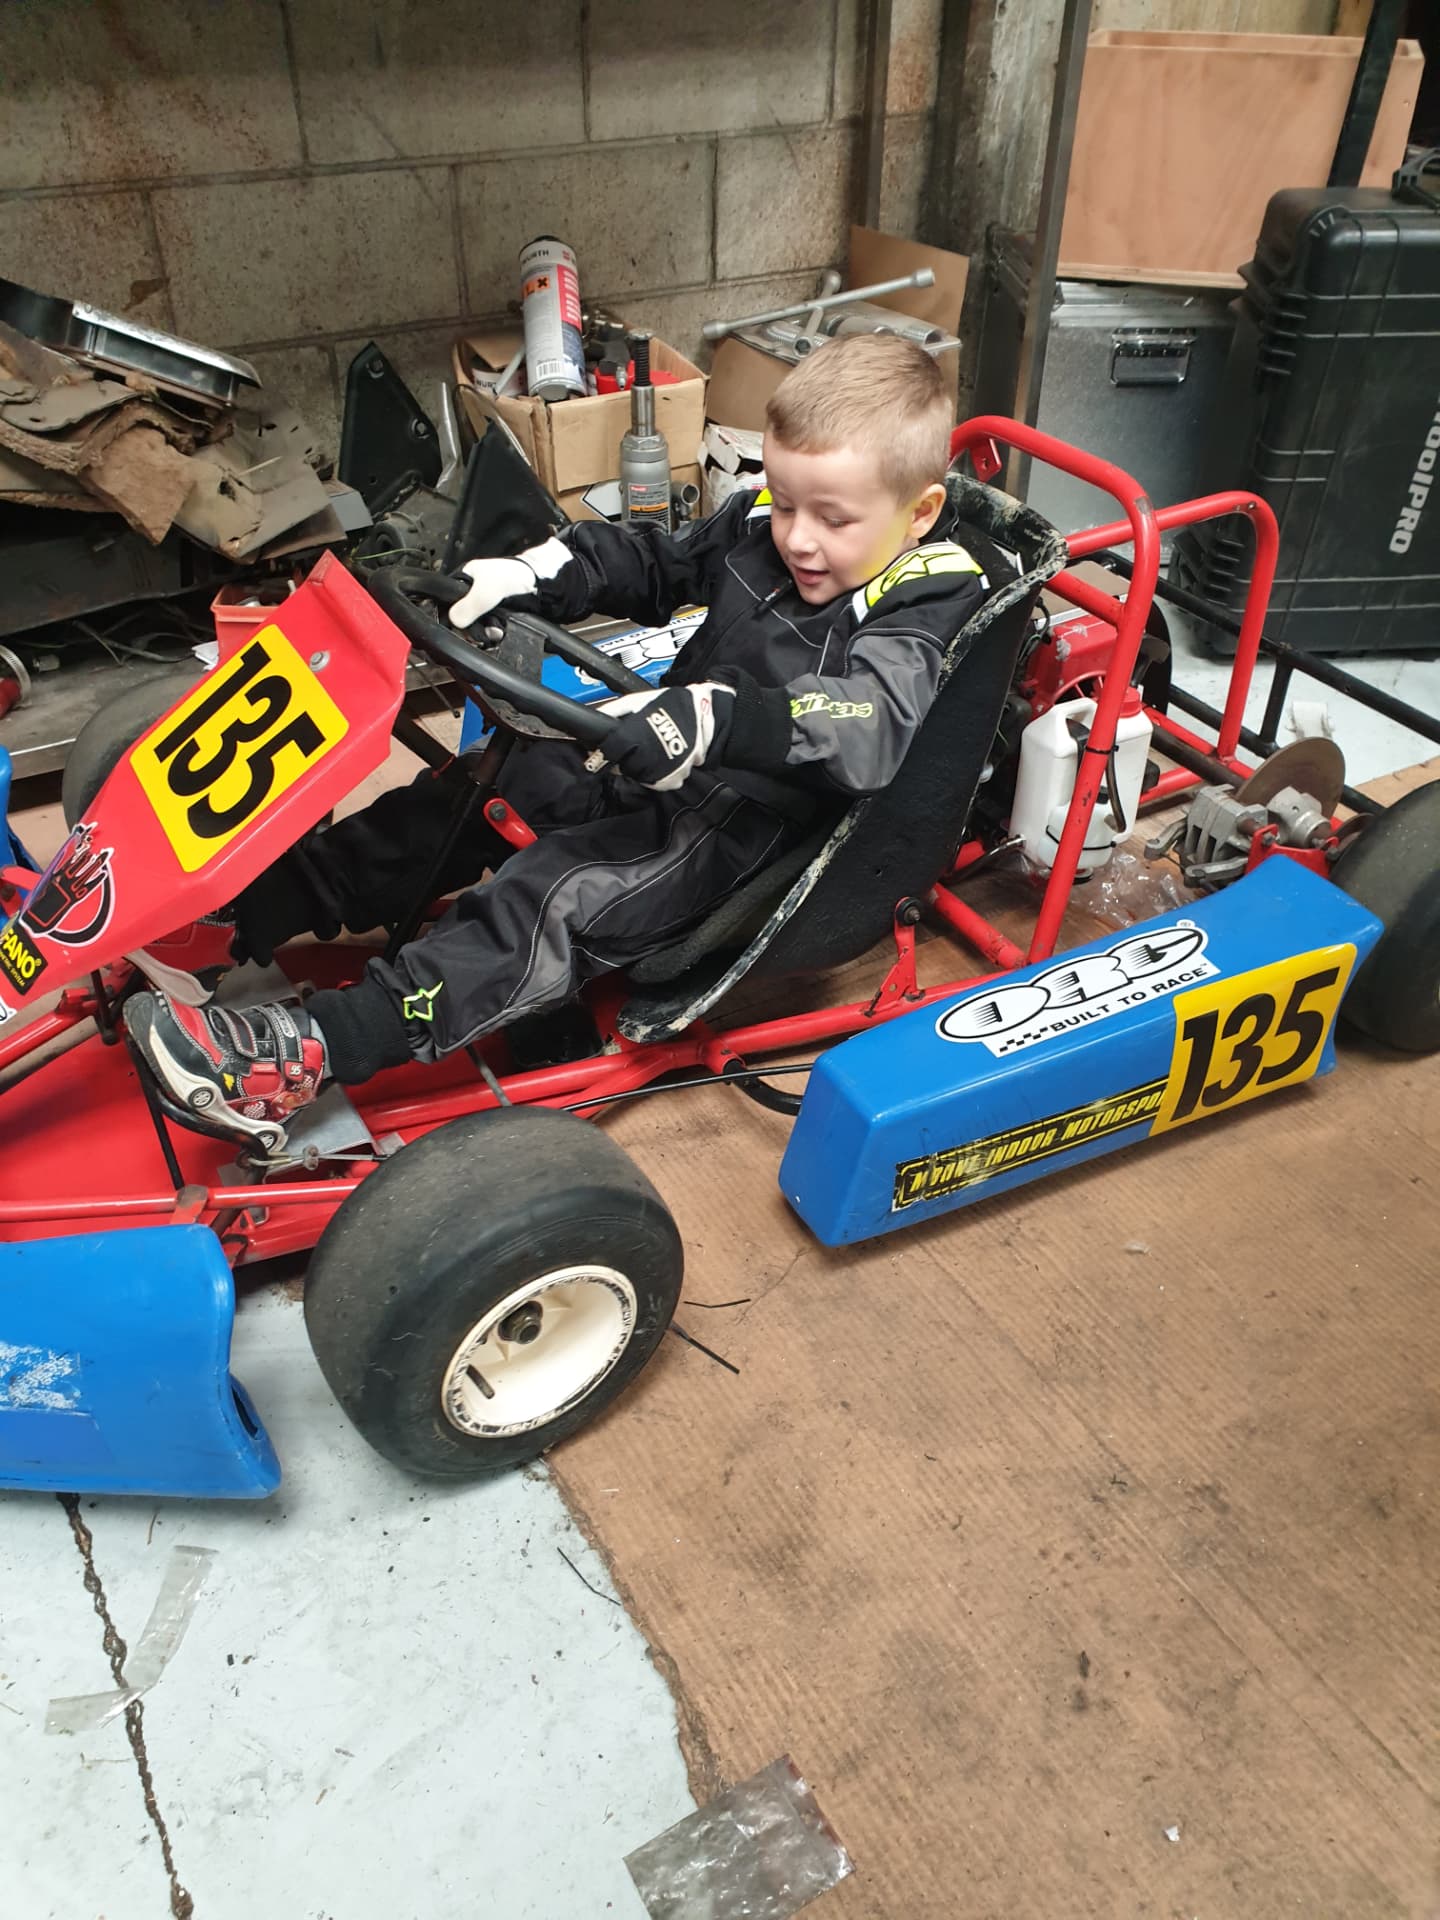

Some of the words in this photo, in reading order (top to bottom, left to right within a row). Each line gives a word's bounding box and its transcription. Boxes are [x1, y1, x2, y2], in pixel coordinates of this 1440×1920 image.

[153, 640, 327, 839] 135
[649, 710, 686, 757] OMP
[1050, 1003, 1111, 1032] BUILT
[1117, 990, 1148, 1006] TO
[1150, 966, 1208, 993] RACE
[289, 1064, 301, 1076] 95
[1169, 966, 1341, 1122] 135
[984, 1127, 1058, 1167] INDOOR
